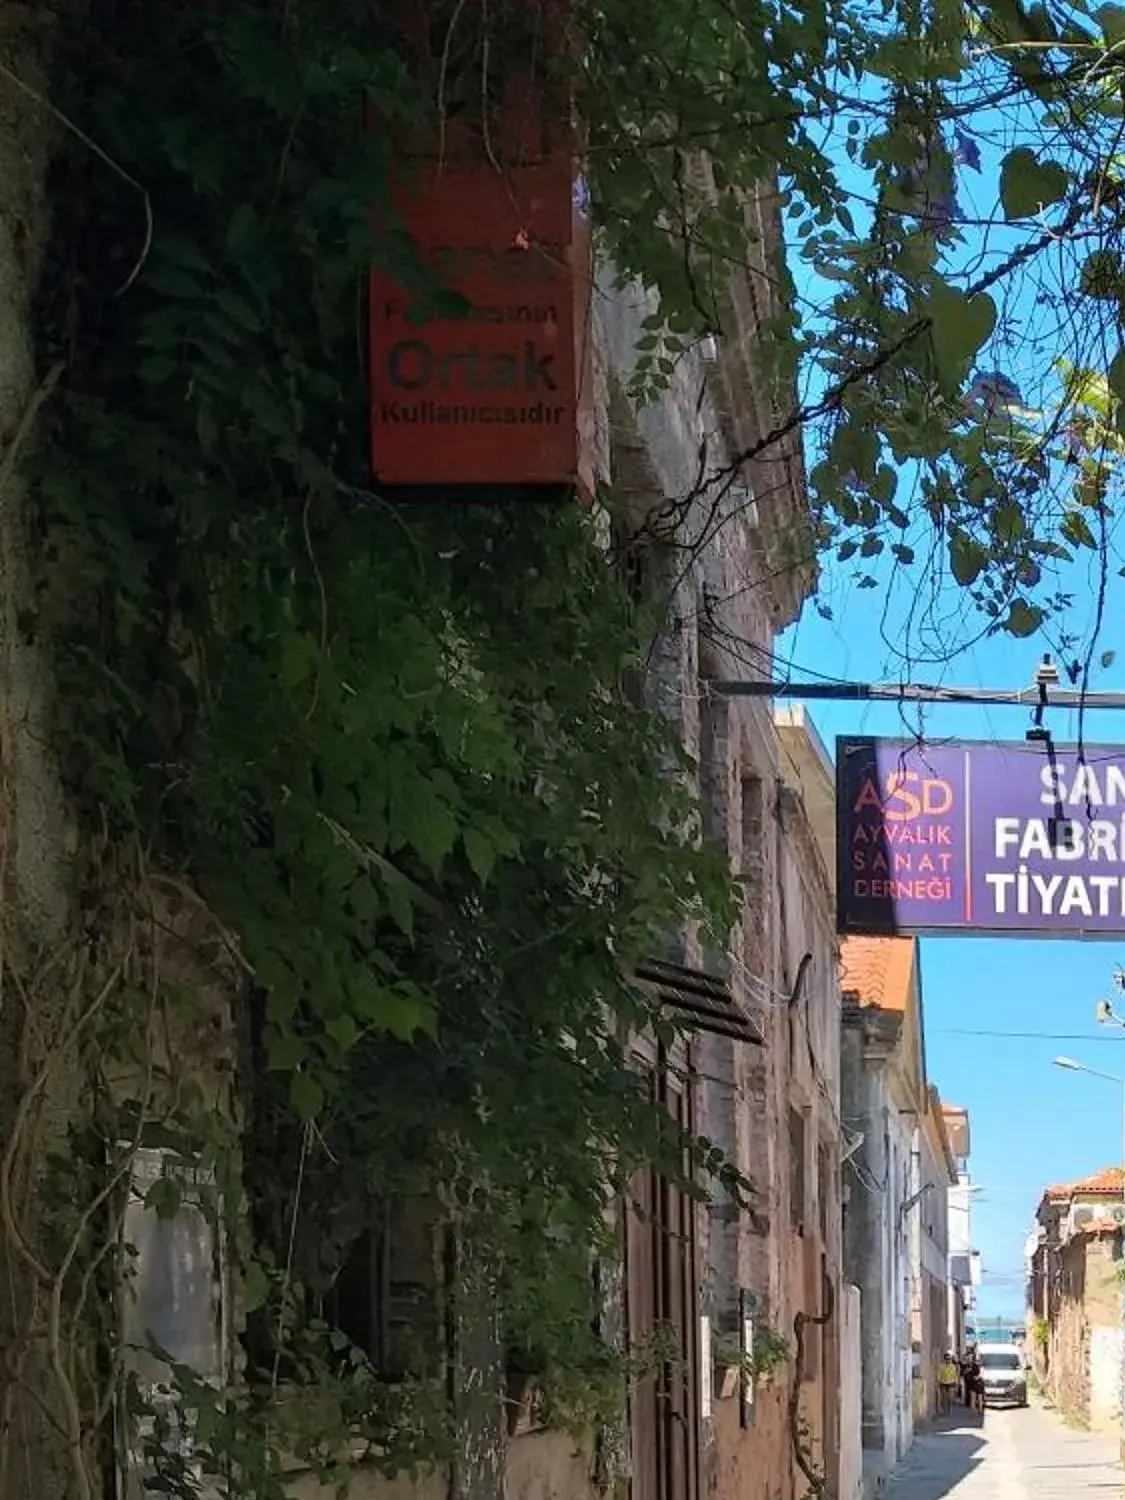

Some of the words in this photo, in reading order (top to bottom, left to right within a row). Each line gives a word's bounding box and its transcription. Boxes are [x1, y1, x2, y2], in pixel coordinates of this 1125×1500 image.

[387, 339, 558, 391] Ortak
[853, 769, 954, 821] ASD
[852, 823, 953, 845] AYVALIK
[852, 850, 953, 872] SANAT
[854, 876, 953, 899] DERNEĞİ
